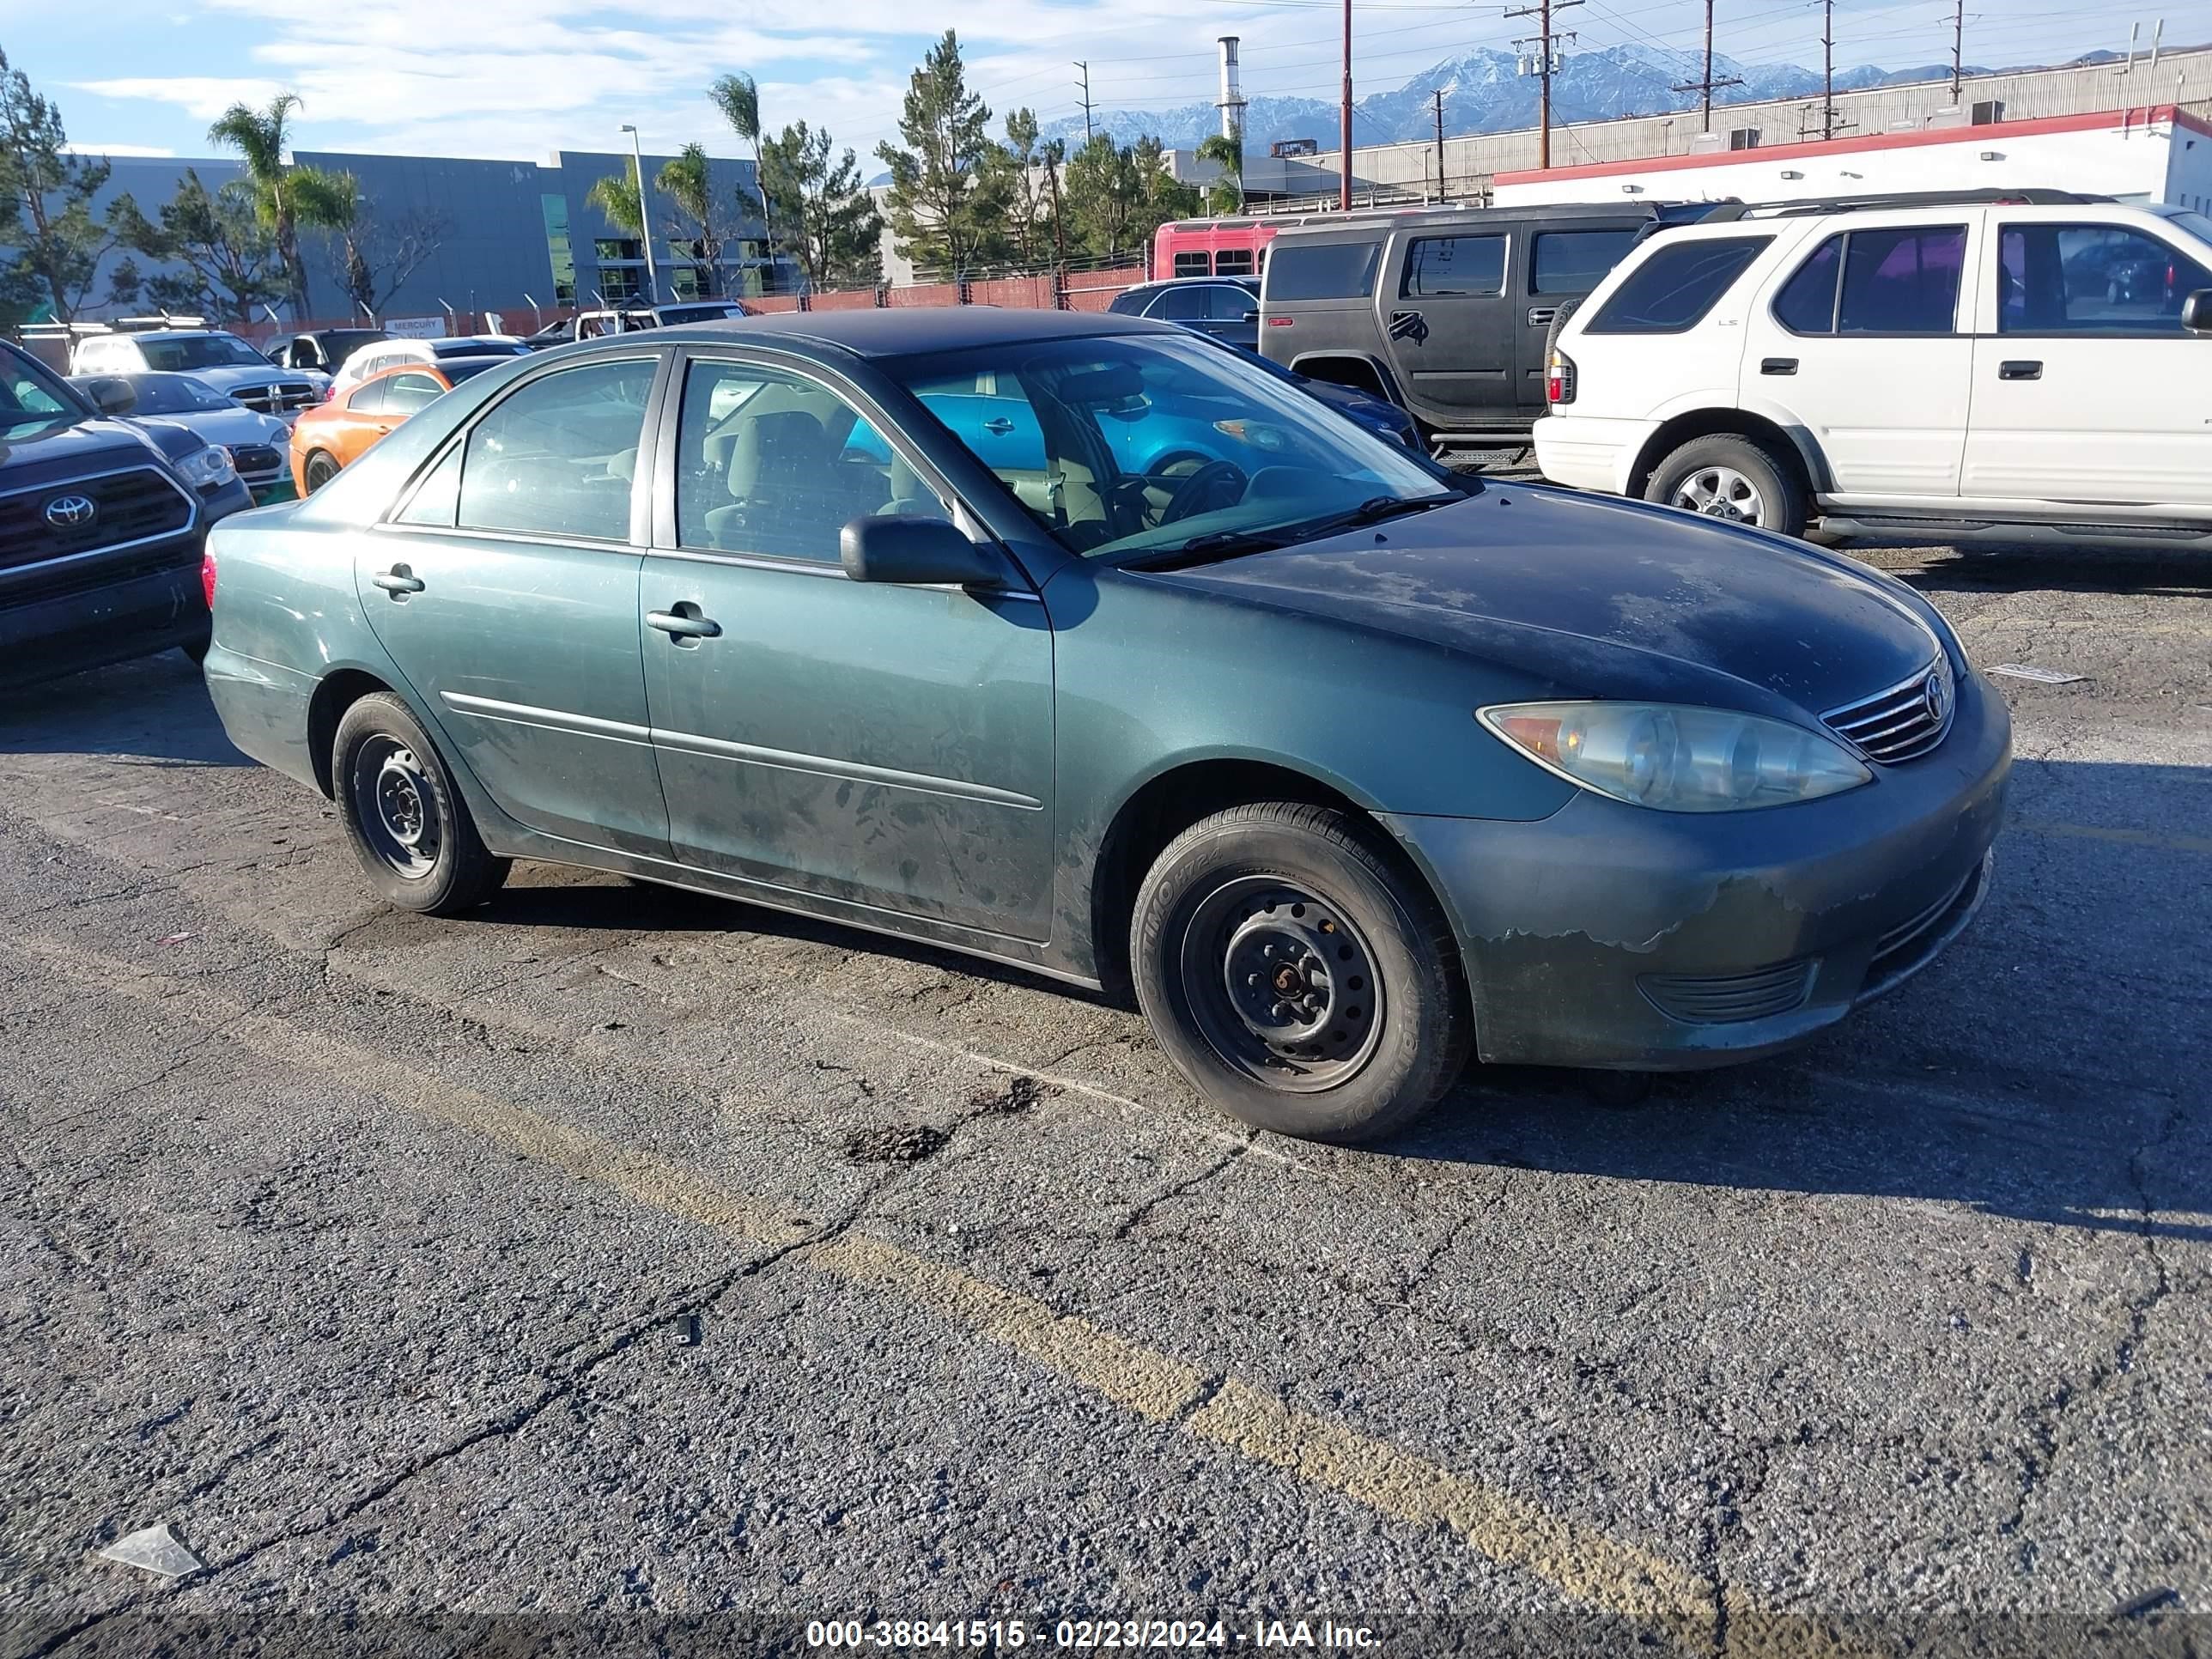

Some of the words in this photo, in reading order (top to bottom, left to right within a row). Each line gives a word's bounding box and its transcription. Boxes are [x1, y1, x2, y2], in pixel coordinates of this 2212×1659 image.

[394, 319, 436, 330] MERCURY
[1142, 880, 1174, 999] OPTIMO
[1174, 847, 1223, 887] H724
